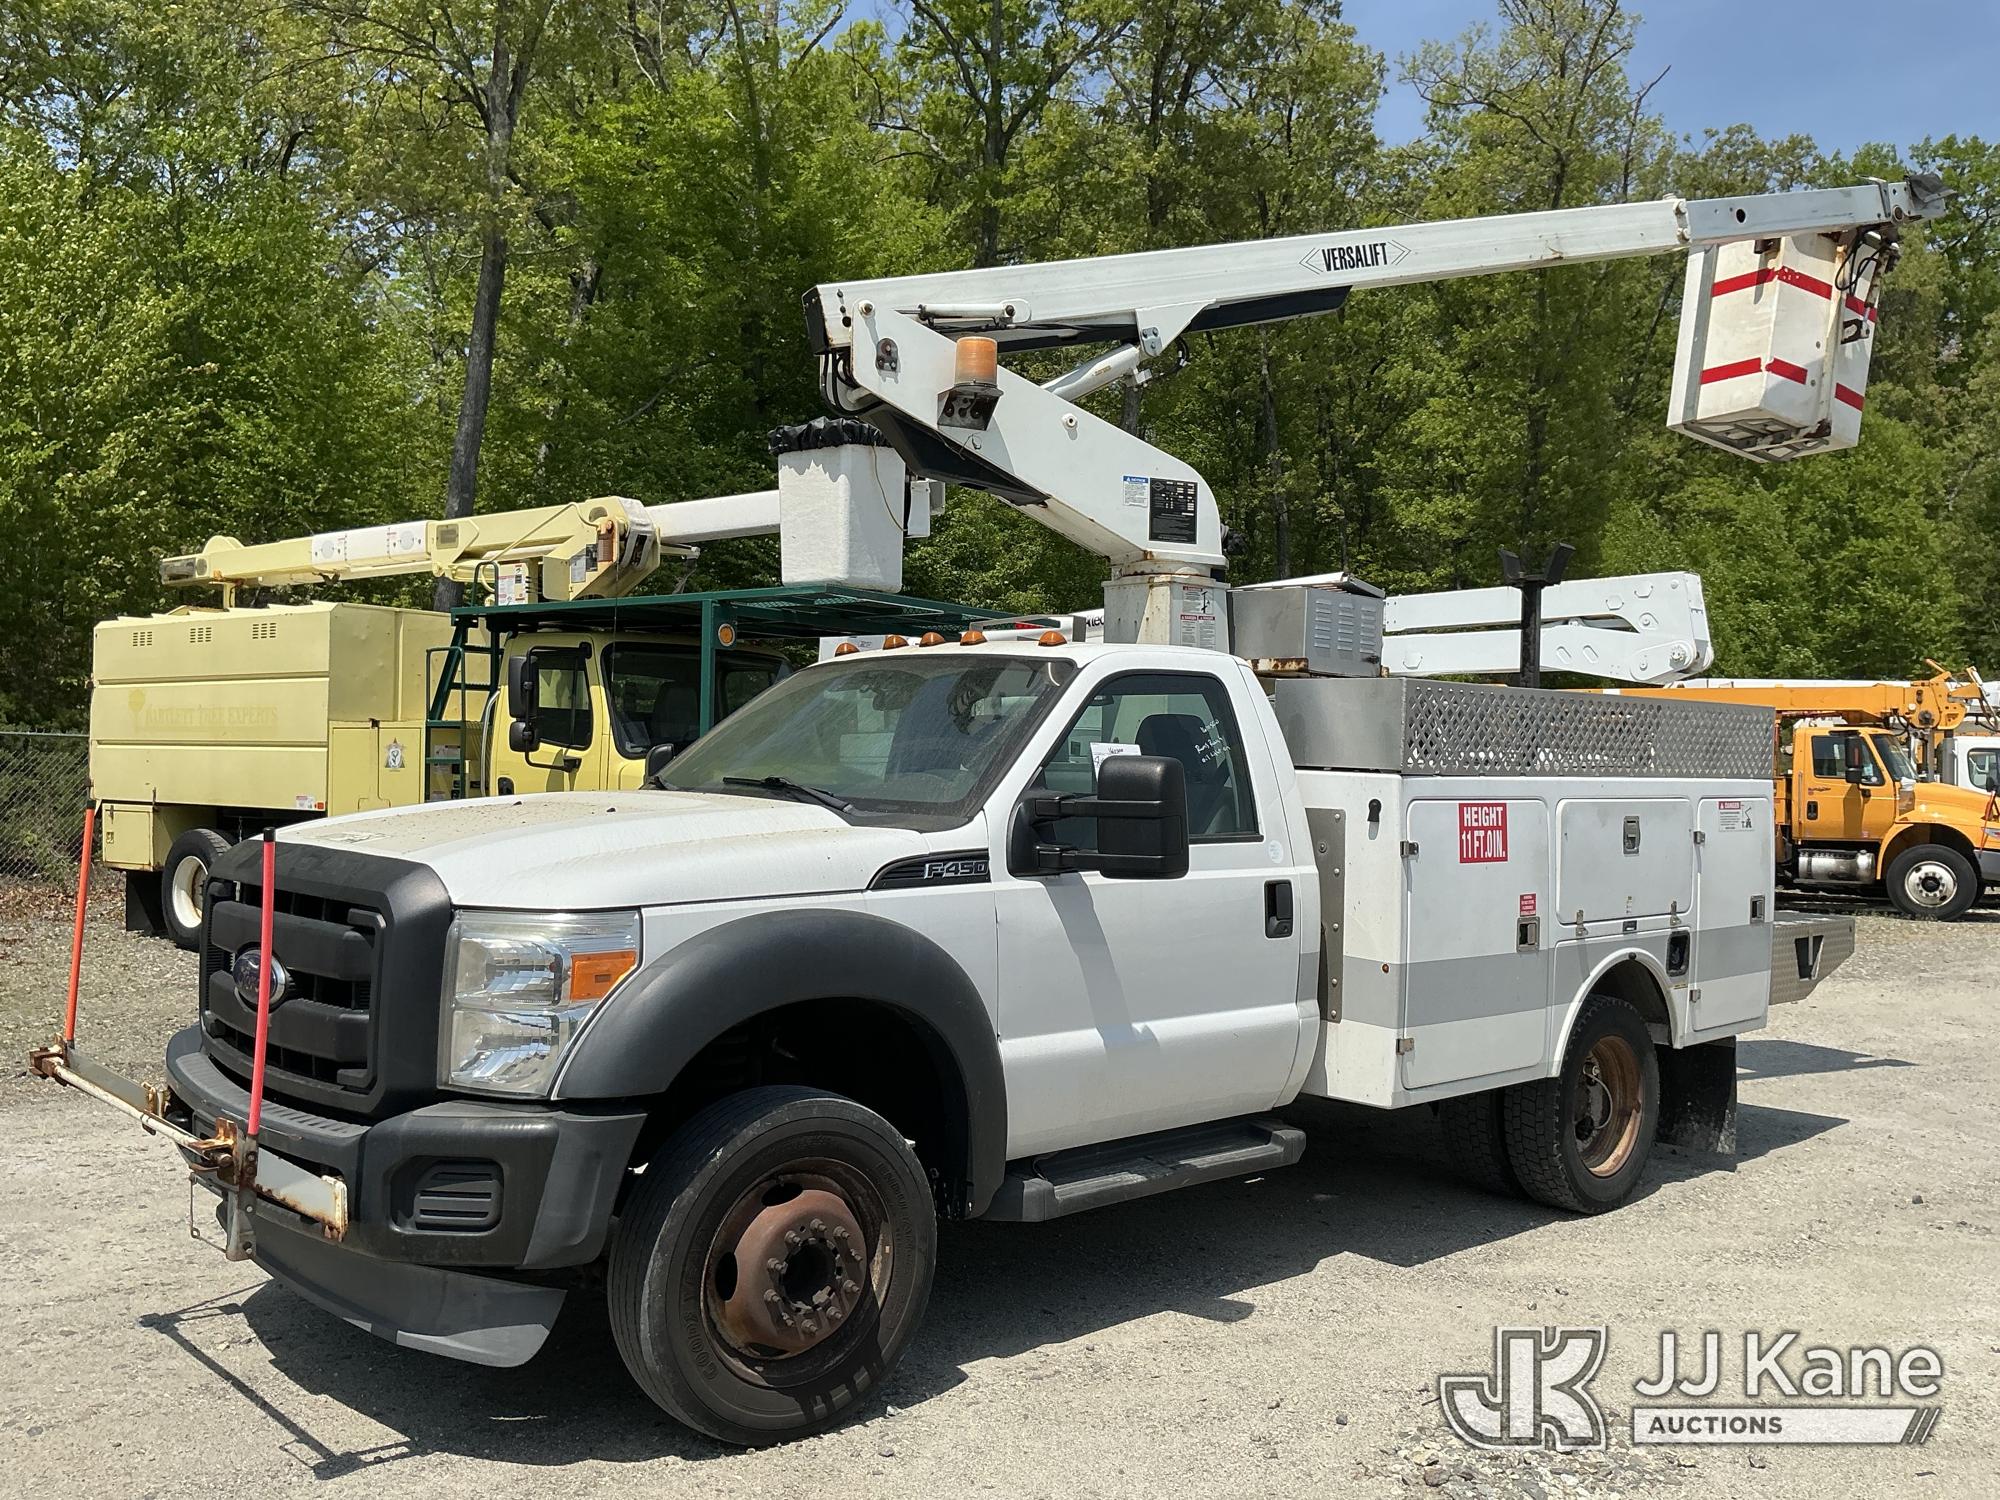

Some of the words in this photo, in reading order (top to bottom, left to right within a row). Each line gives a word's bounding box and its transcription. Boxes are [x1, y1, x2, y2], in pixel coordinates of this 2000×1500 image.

[1322, 242, 1388, 272] VERSALIFT
[1463, 806, 1504, 828] HEIGHT
[1461, 830, 1472, 859] 11
